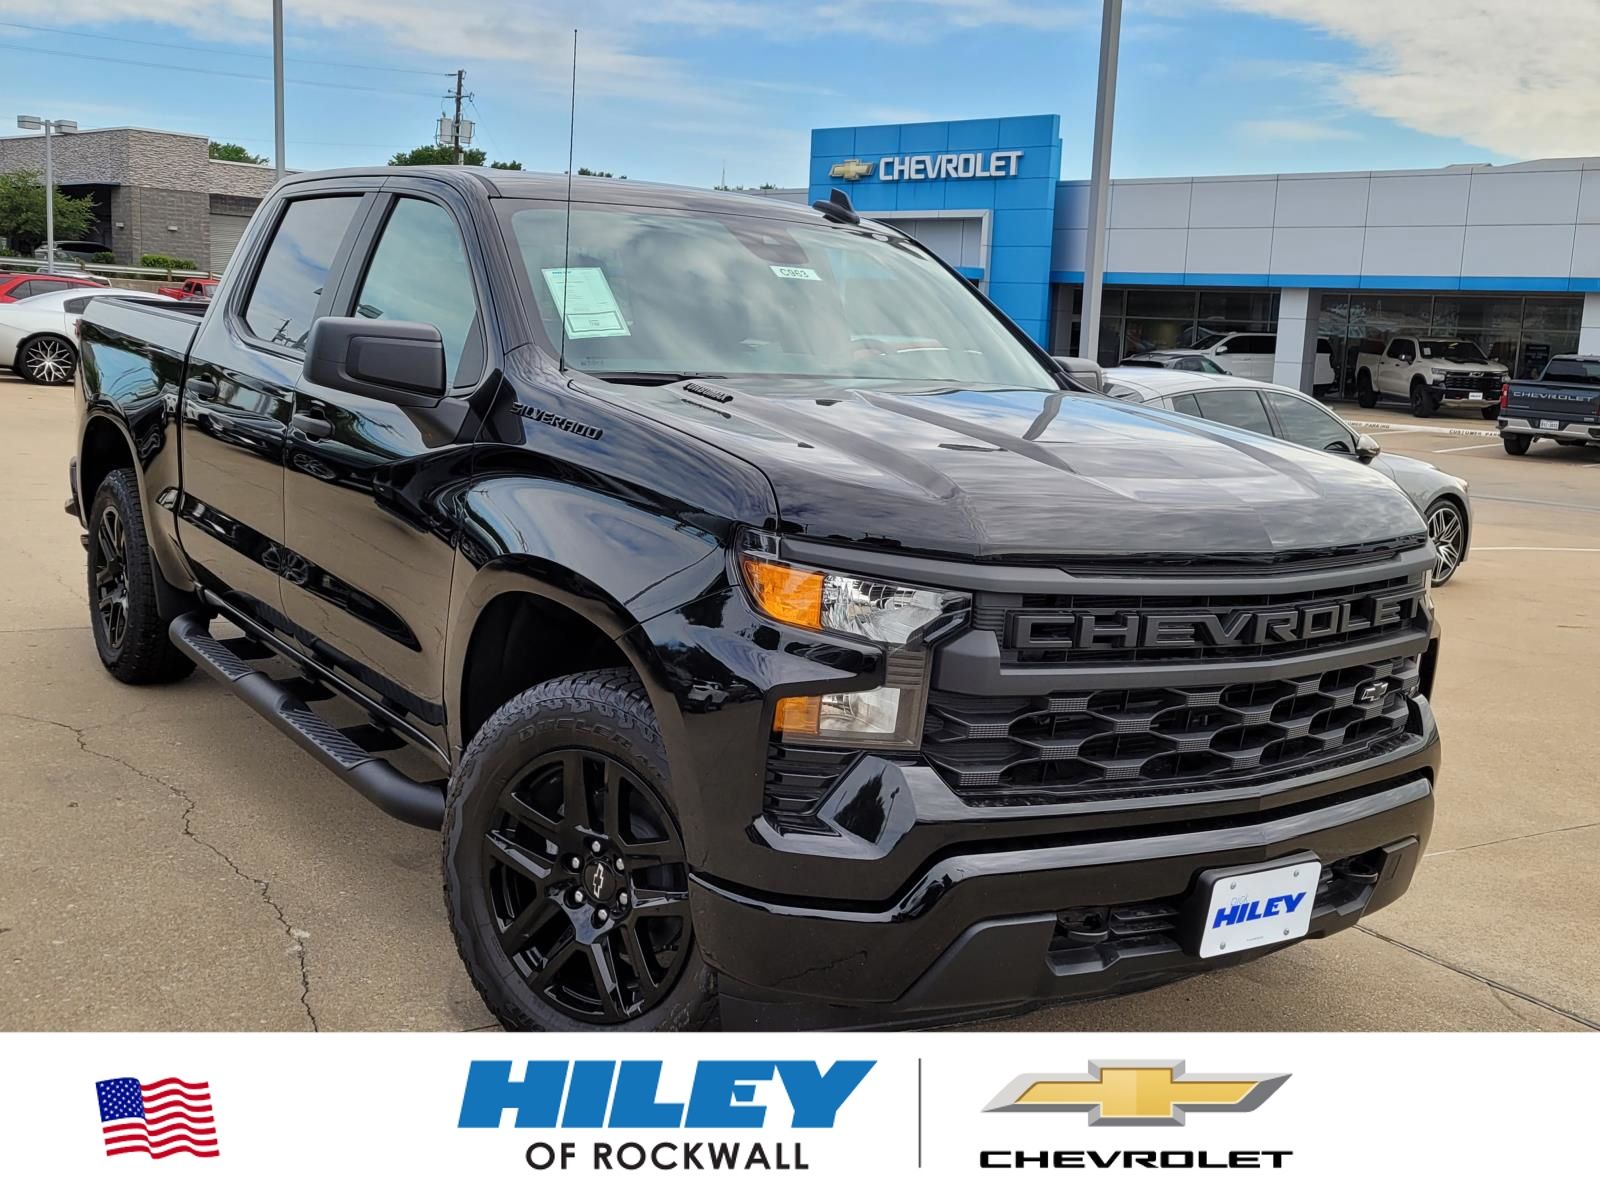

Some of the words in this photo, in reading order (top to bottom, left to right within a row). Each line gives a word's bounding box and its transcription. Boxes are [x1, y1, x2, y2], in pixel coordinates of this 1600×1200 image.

[879, 150, 1025, 181] CHEVROLET
[1512, 391, 1594, 402] CHEVROLET
[510, 402, 604, 440] SILVERADO
[1004, 594, 1420, 649] CHEVROLET
[1212, 892, 1307, 929] HILEY
